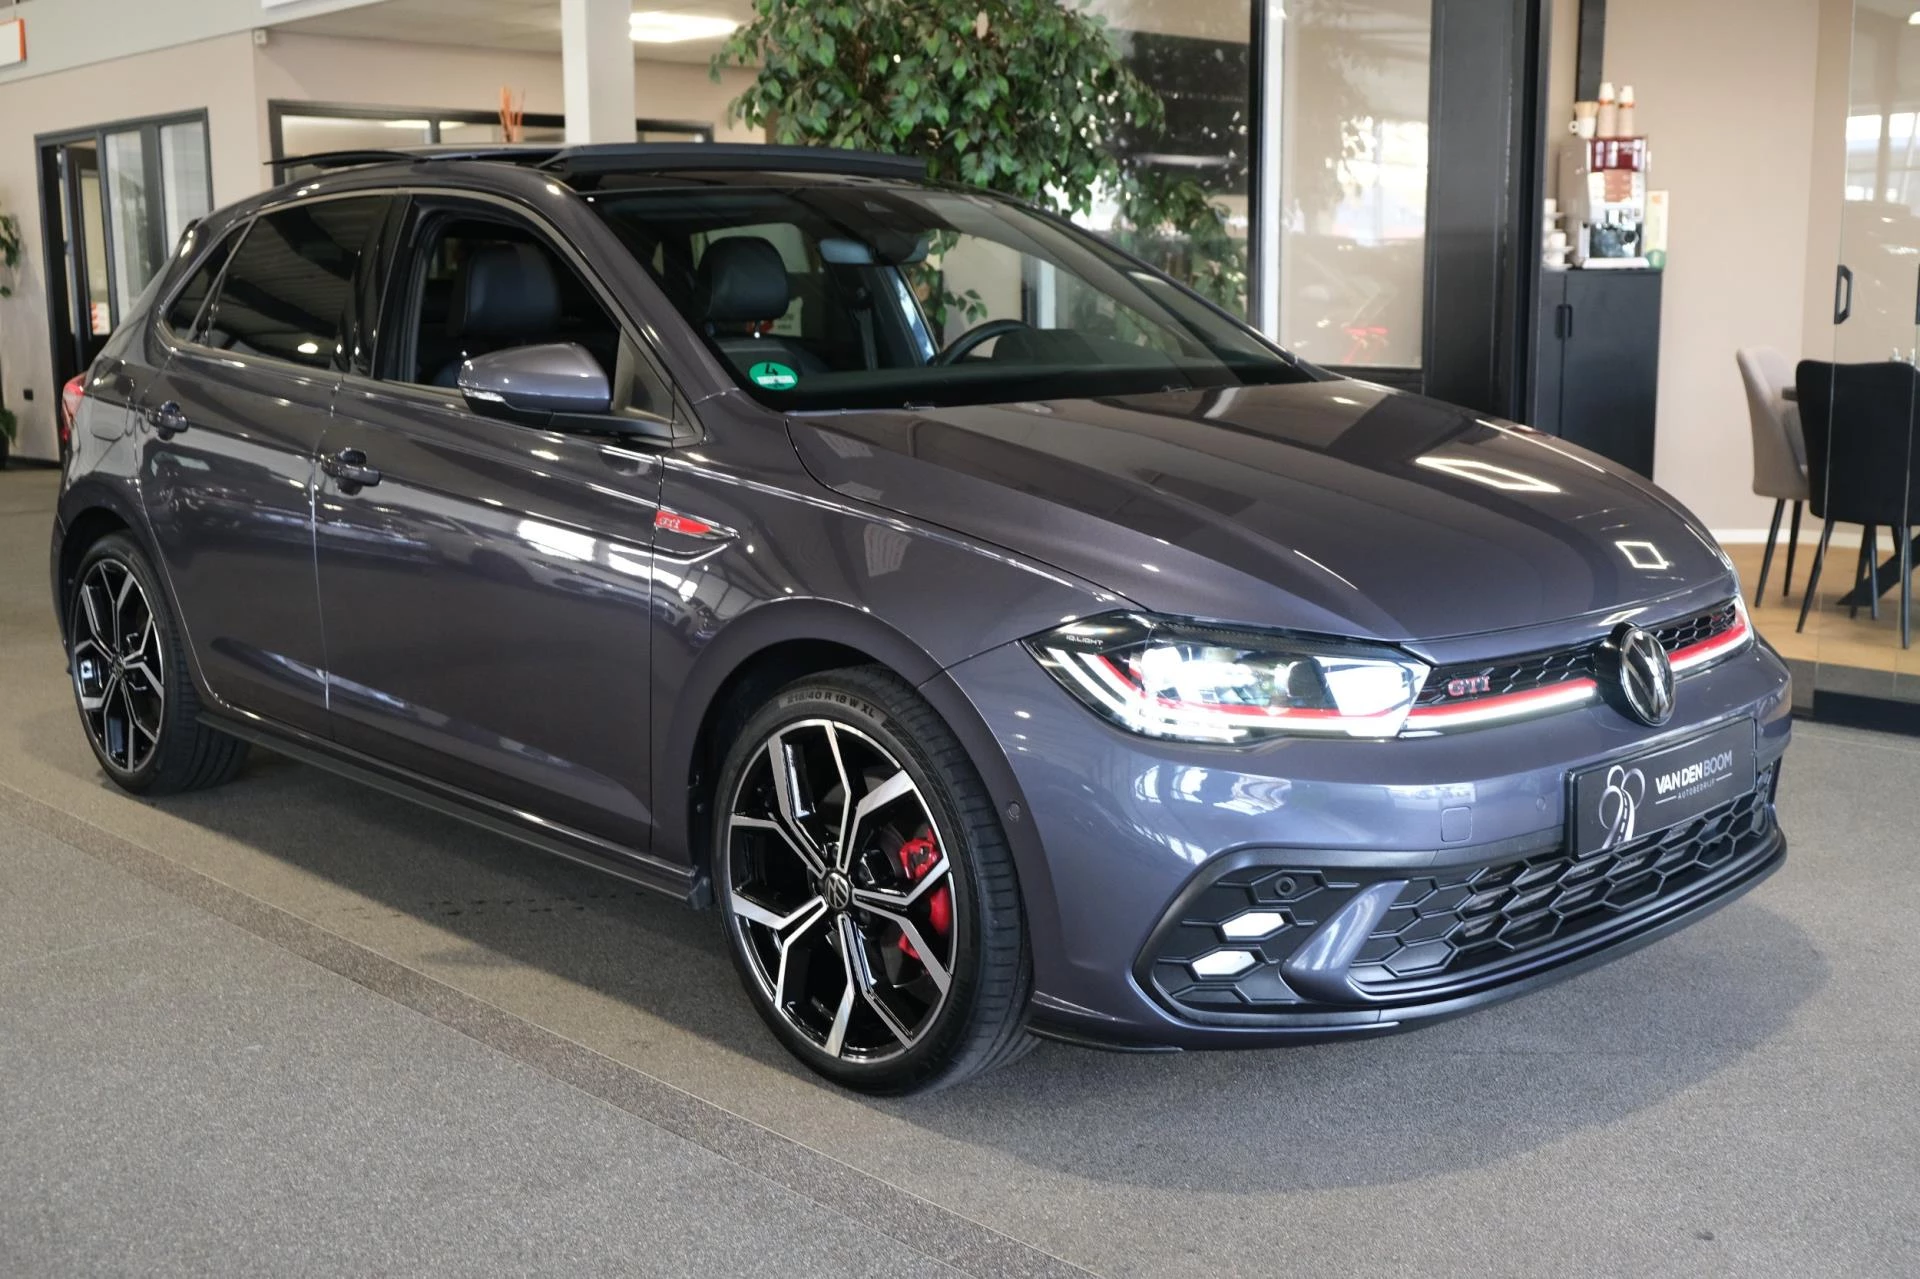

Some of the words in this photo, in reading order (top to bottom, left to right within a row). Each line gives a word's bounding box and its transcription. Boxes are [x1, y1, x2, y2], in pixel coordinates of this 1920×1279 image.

[1448, 675, 1490, 697] GTI
[824, 691, 832, 701] R
[835, 694, 848, 704] 18
[849, 697, 860, 709] W
[861, 703, 875, 719] XL
[1655, 770, 1681, 795] VAN
[1681, 762, 1703, 787] DEN
[1703, 749, 1733, 777] BOOM
[1677, 777, 1716, 801] AUTOBEDRIJF
